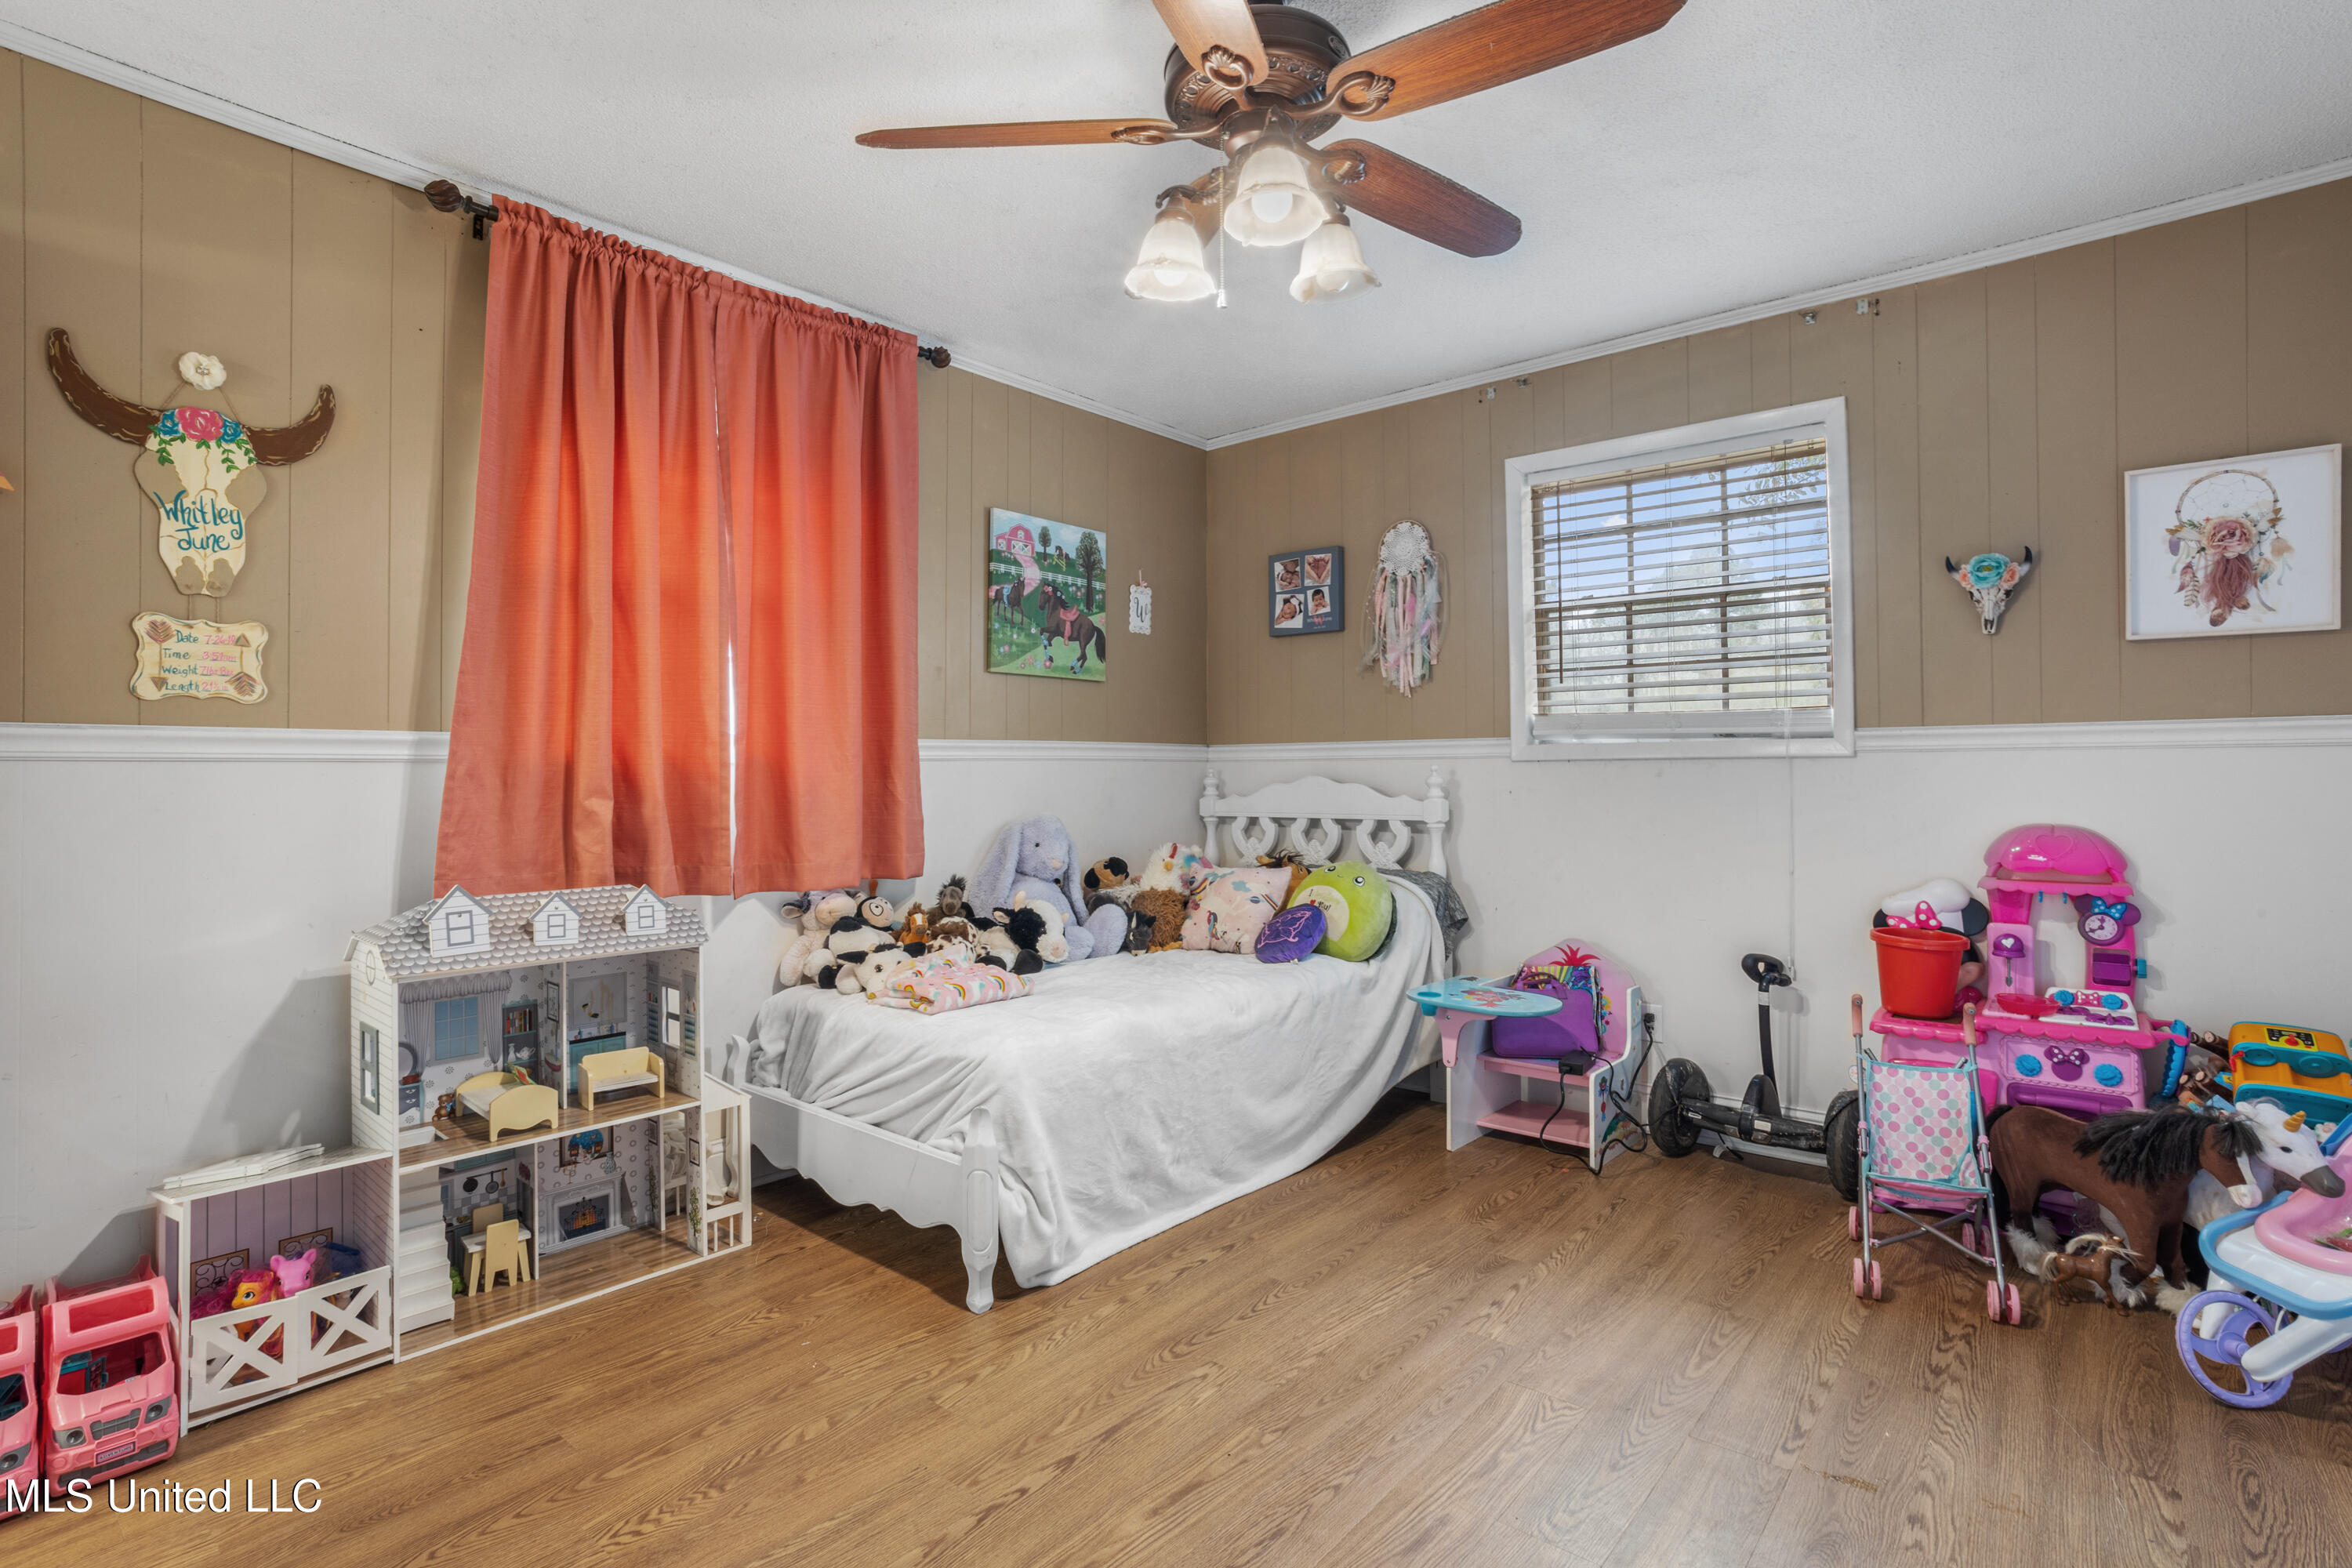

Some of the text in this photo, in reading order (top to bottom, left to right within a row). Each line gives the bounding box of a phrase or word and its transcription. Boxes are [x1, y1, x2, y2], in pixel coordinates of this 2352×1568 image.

[153, 489, 243, 540] Whitley
[175, 526, 230, 552] June
[176, 629, 199, 644] Date
[162, 648, 191, 660] Time
[162, 663, 198, 677] Weight
[165, 680, 200, 693] Length
